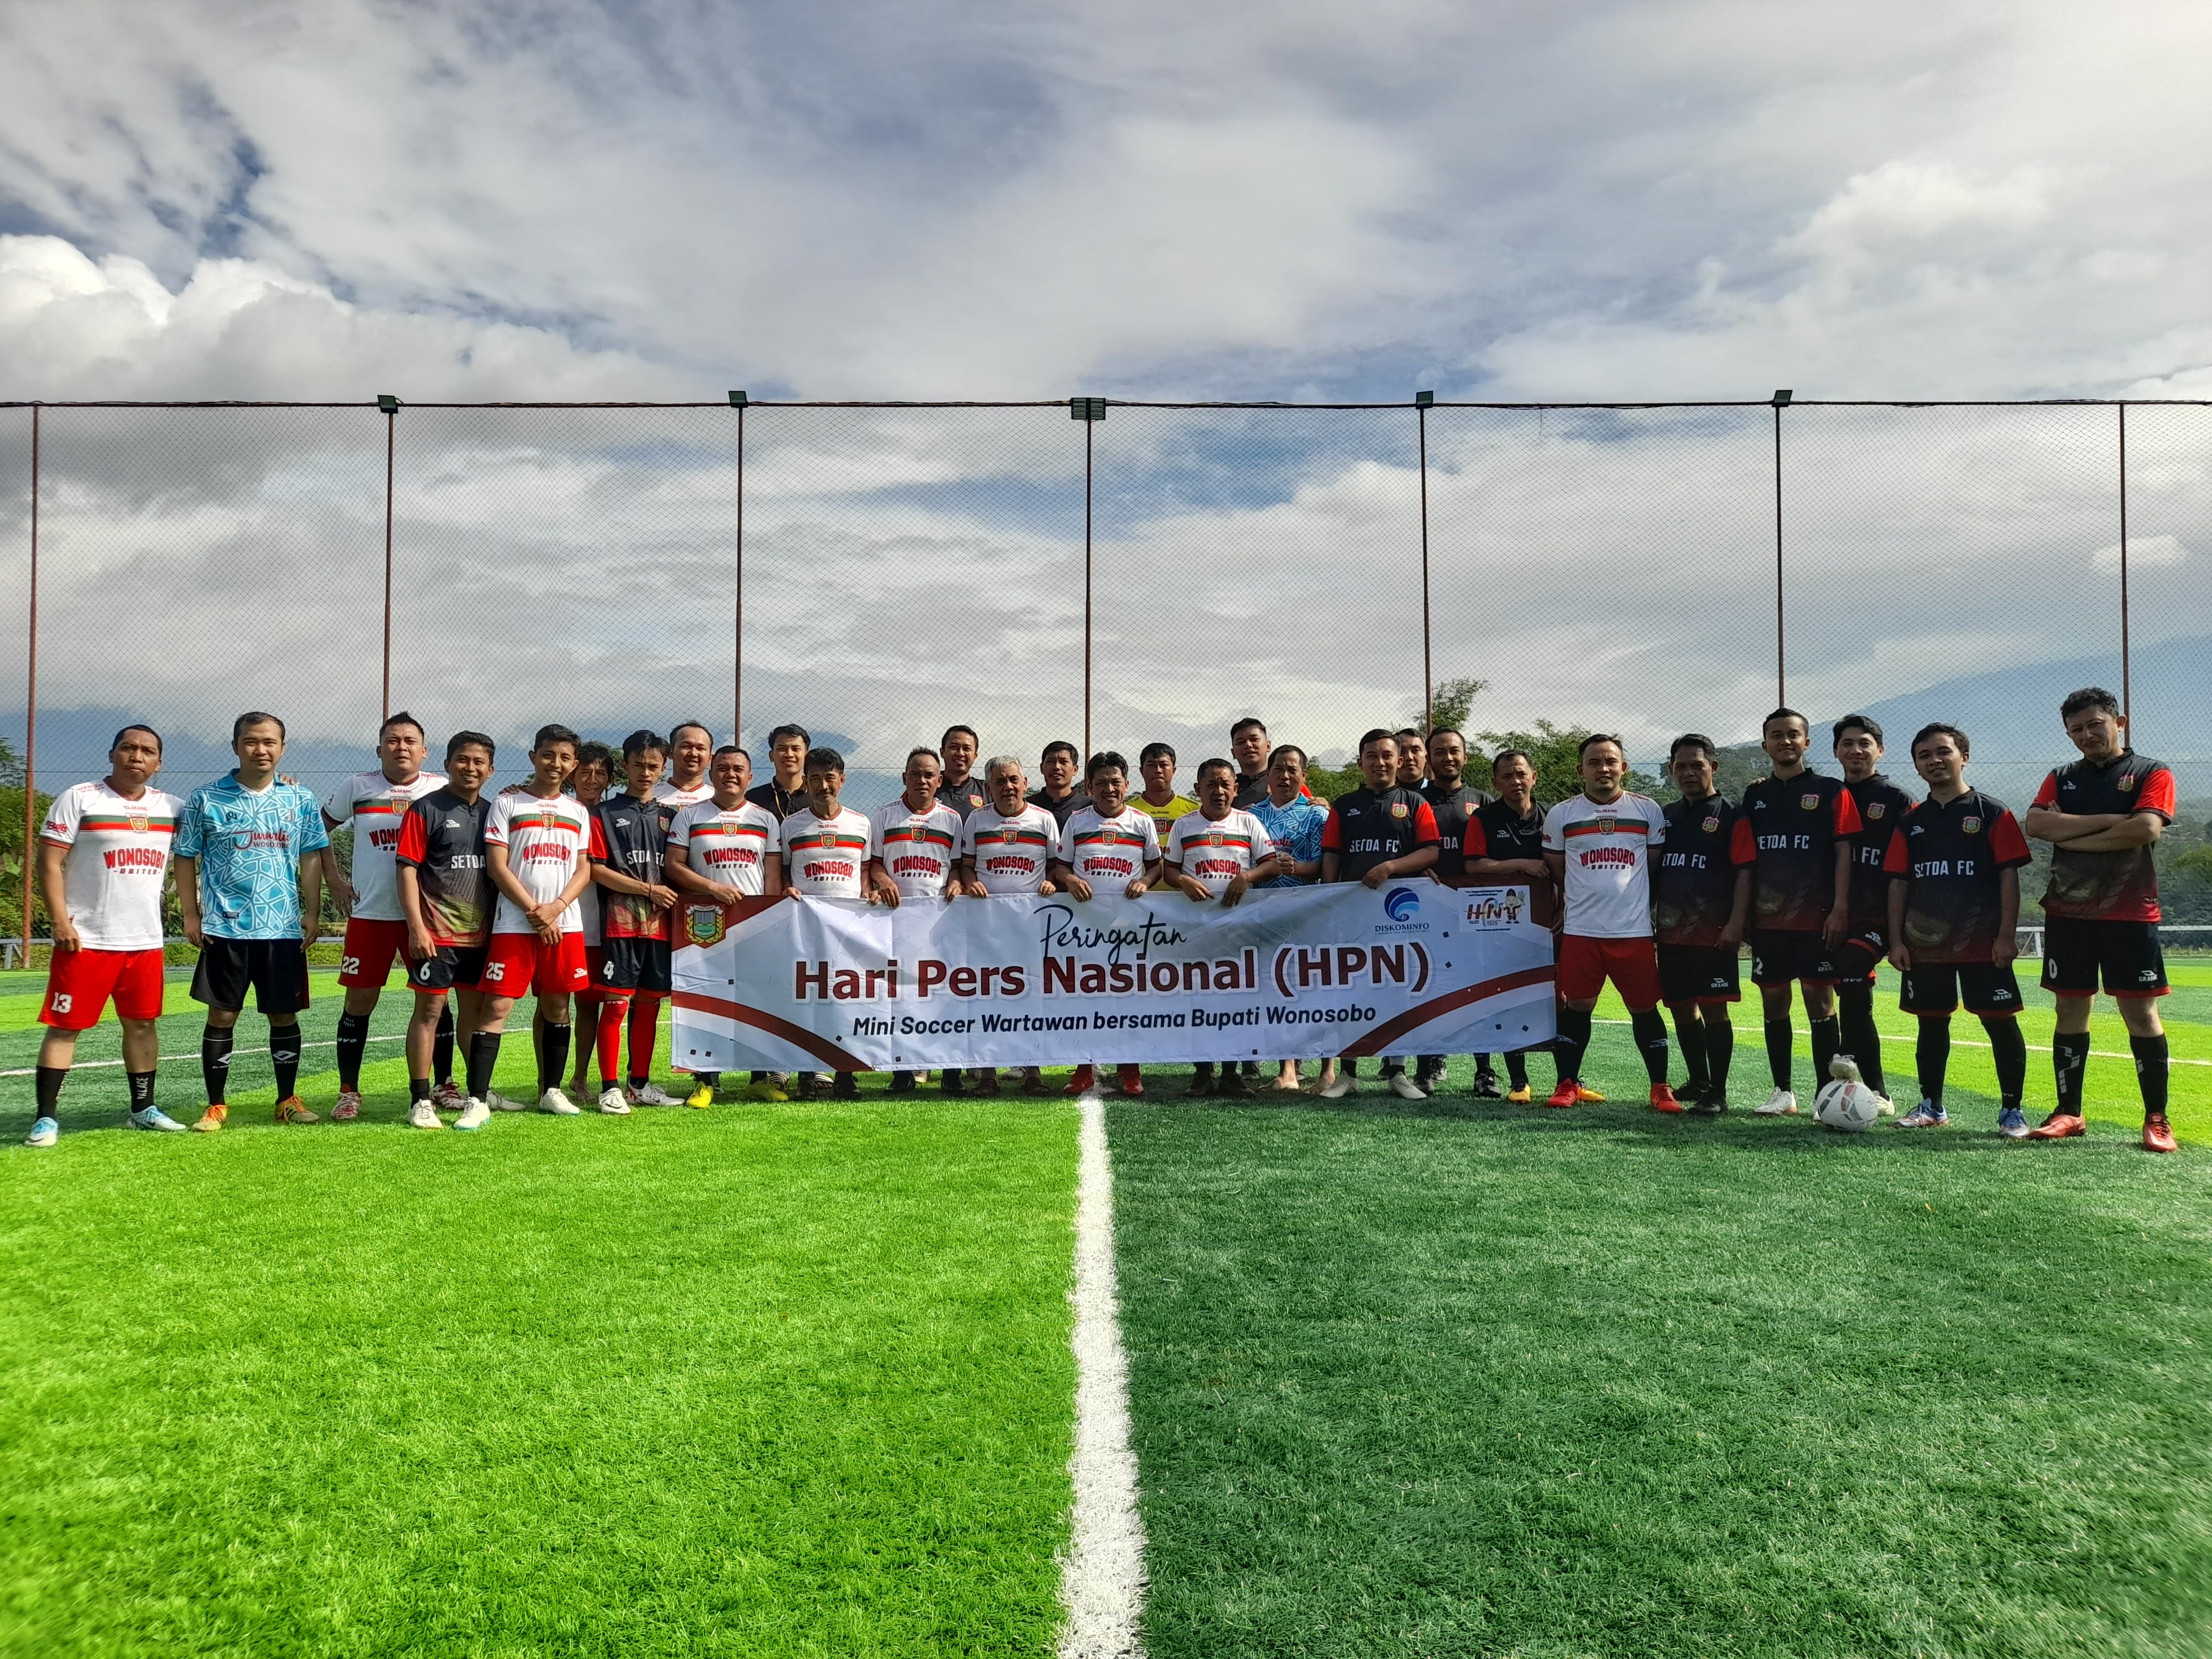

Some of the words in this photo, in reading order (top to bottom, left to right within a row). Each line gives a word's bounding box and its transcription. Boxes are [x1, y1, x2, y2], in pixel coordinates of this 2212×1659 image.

[1350, 839, 1379, 853] SETDA
[1386, 839, 1399, 853] FC
[1757, 835, 1787, 849] ETDA
[1794, 835, 1809, 849] FC
[103, 848, 165, 869] WONOSOBO
[451, 854, 486, 869] SETDA
[893, 855, 942, 875] WONOSOBO
[986, 856, 1035, 873] WONOSOBO
[1580, 847, 1635, 867] WONOSOBO
[1692, 854, 1706, 869] FC
[1861, 847, 1880, 865] FC
[1083, 857, 1133, 875] WONOSOBO
[1957, 860, 1974, 875] FC
[1034, 904, 1187, 966] Peringatan
[1375, 923, 1430, 932] DISKOMINFO
[342, 956, 359, 974] 22
[420, 962, 430, 980] 6
[486, 962, 505, 980] 25
[603, 961, 614, 979] 4
[796, 959, 897, 999] Hari
[918, 960, 1025, 997] Pers
[1044, 950, 1255, 994] Nasional
[1275, 942, 1429, 997] (HPN)
[51, 992, 72, 1013] 13
[853, 1016, 895, 1035] Mini
[901, 1016, 975, 1035] Soccer
[982, 1014, 1087, 1032] Wartawan
[1093, 1011, 1185, 1029] bersama
[1191, 1006, 1260, 1030] Bupati
[1266, 1004, 1376, 1024] Wonosobo
